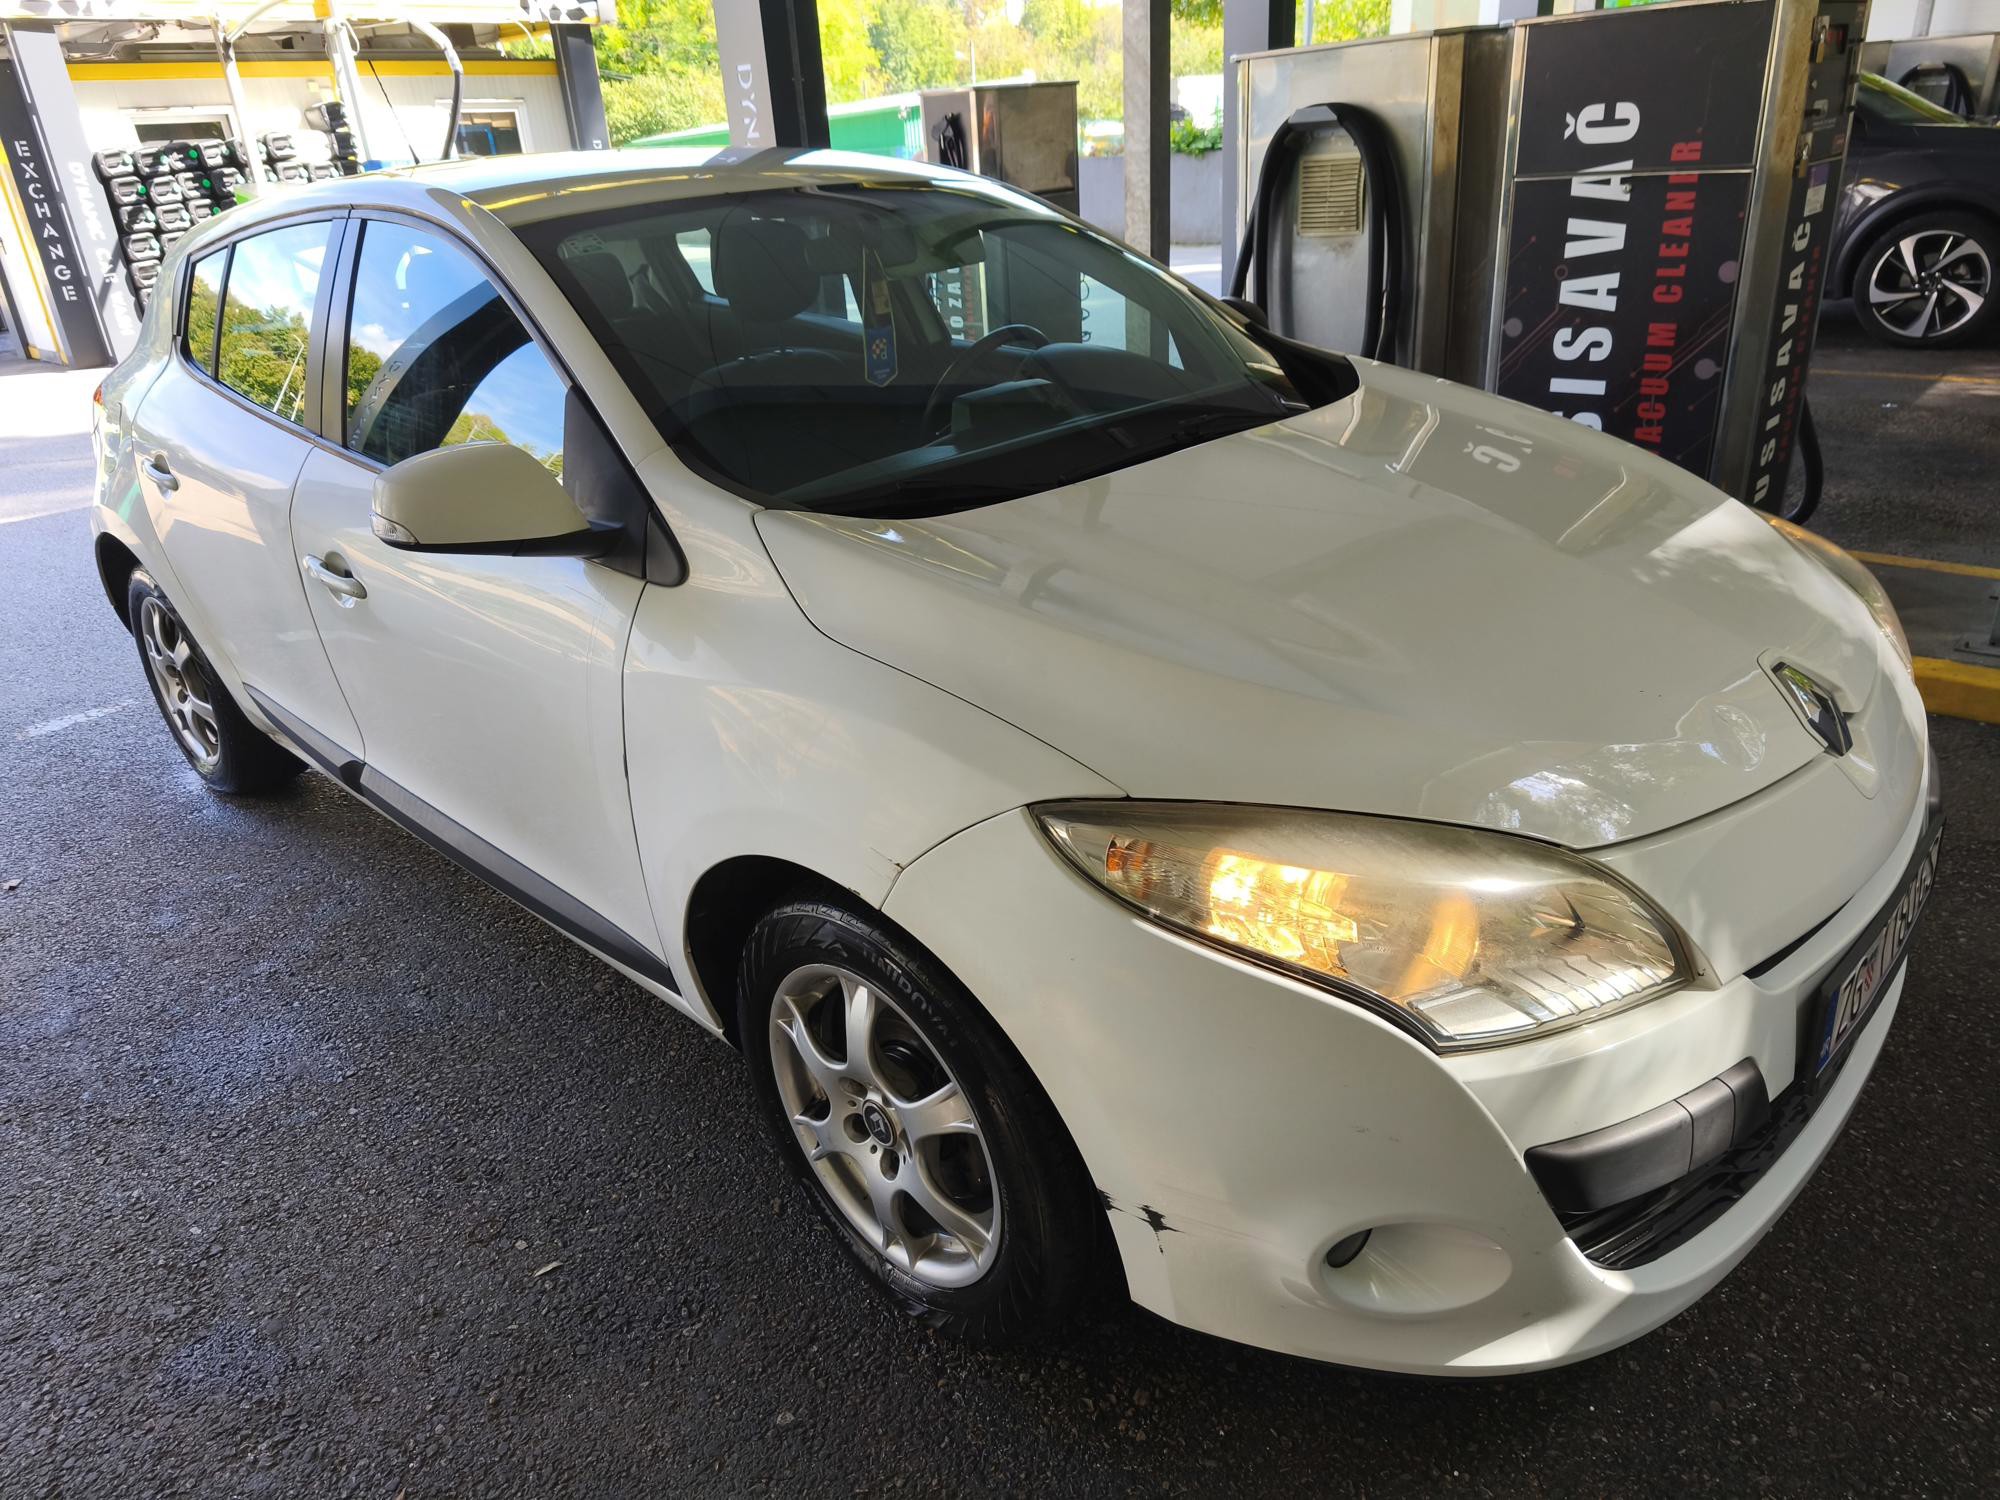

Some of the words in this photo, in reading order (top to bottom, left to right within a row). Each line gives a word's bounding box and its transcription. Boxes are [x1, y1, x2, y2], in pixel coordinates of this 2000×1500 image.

[736, 63, 761, 148] DYN
[14, 140, 79, 302] EXCHANGE
[1652, 141, 1703, 305] CLEANER
[1633, 322, 1678, 455] ACUUM
[1754, 221, 1811, 504] USISAVAČ
[1835, 957, 1869, 1043] ZG
